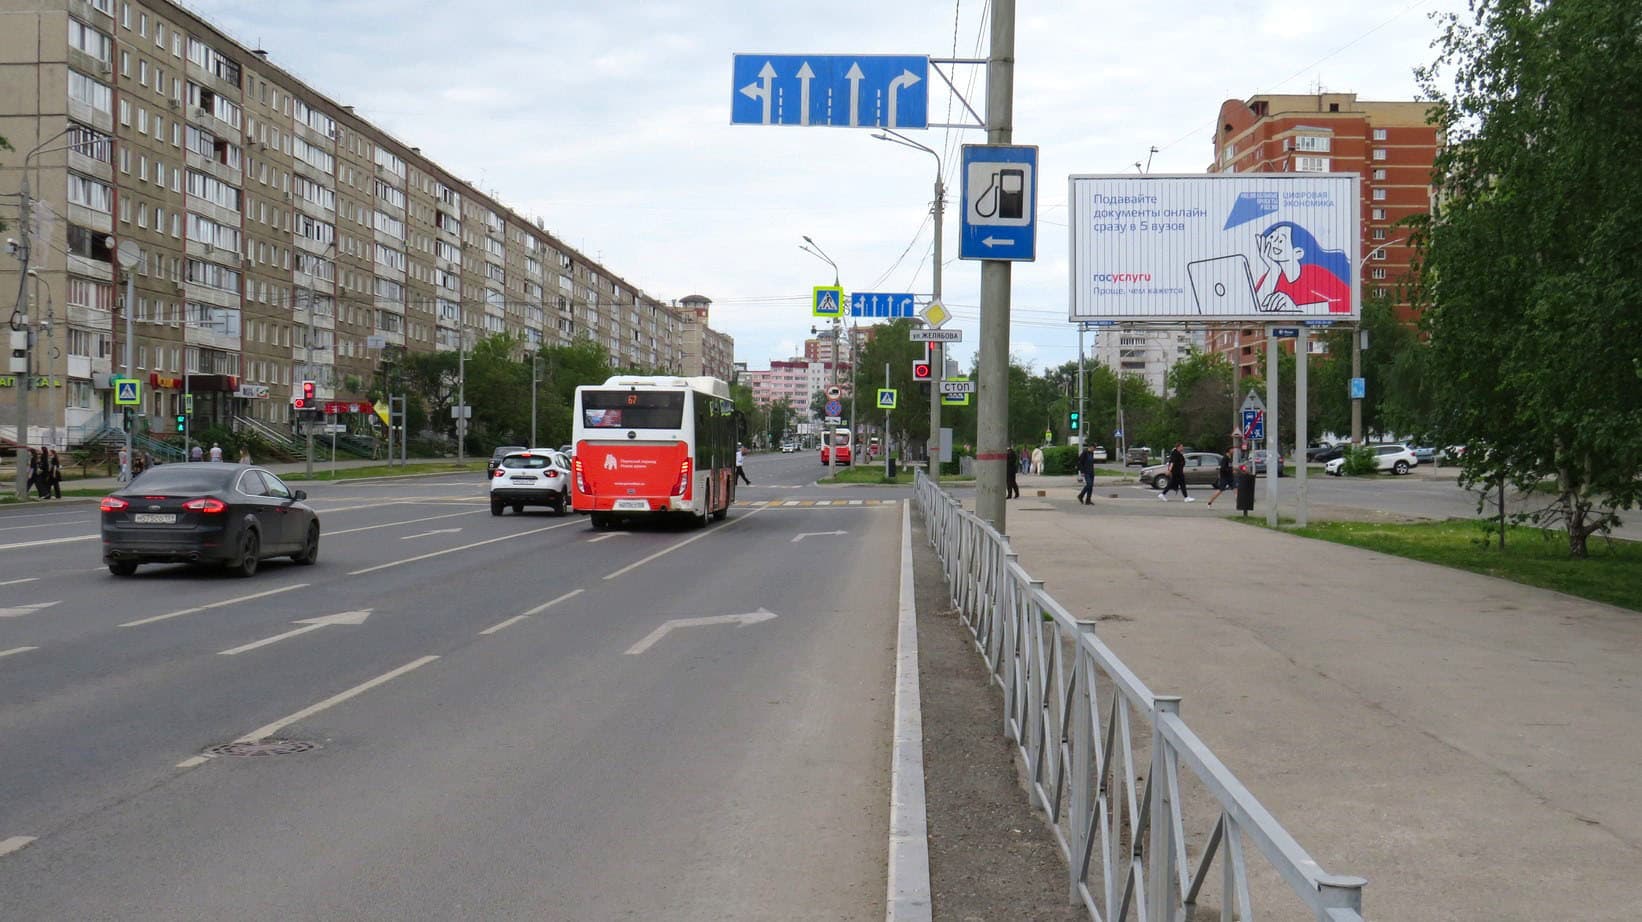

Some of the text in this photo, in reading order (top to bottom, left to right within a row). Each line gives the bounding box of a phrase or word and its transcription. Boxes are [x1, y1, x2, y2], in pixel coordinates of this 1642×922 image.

[1093, 193, 1157, 206] Подавайте
[1283, 200, 1335, 208] ЭКОНОМИКА
[1093, 207, 1207, 219] документы онлайн
[1093, 221, 1185, 233] сразу в 5 вузов
[1093, 273, 1151, 284] госуслуги
[944, 383, 970, 392] СТОП
